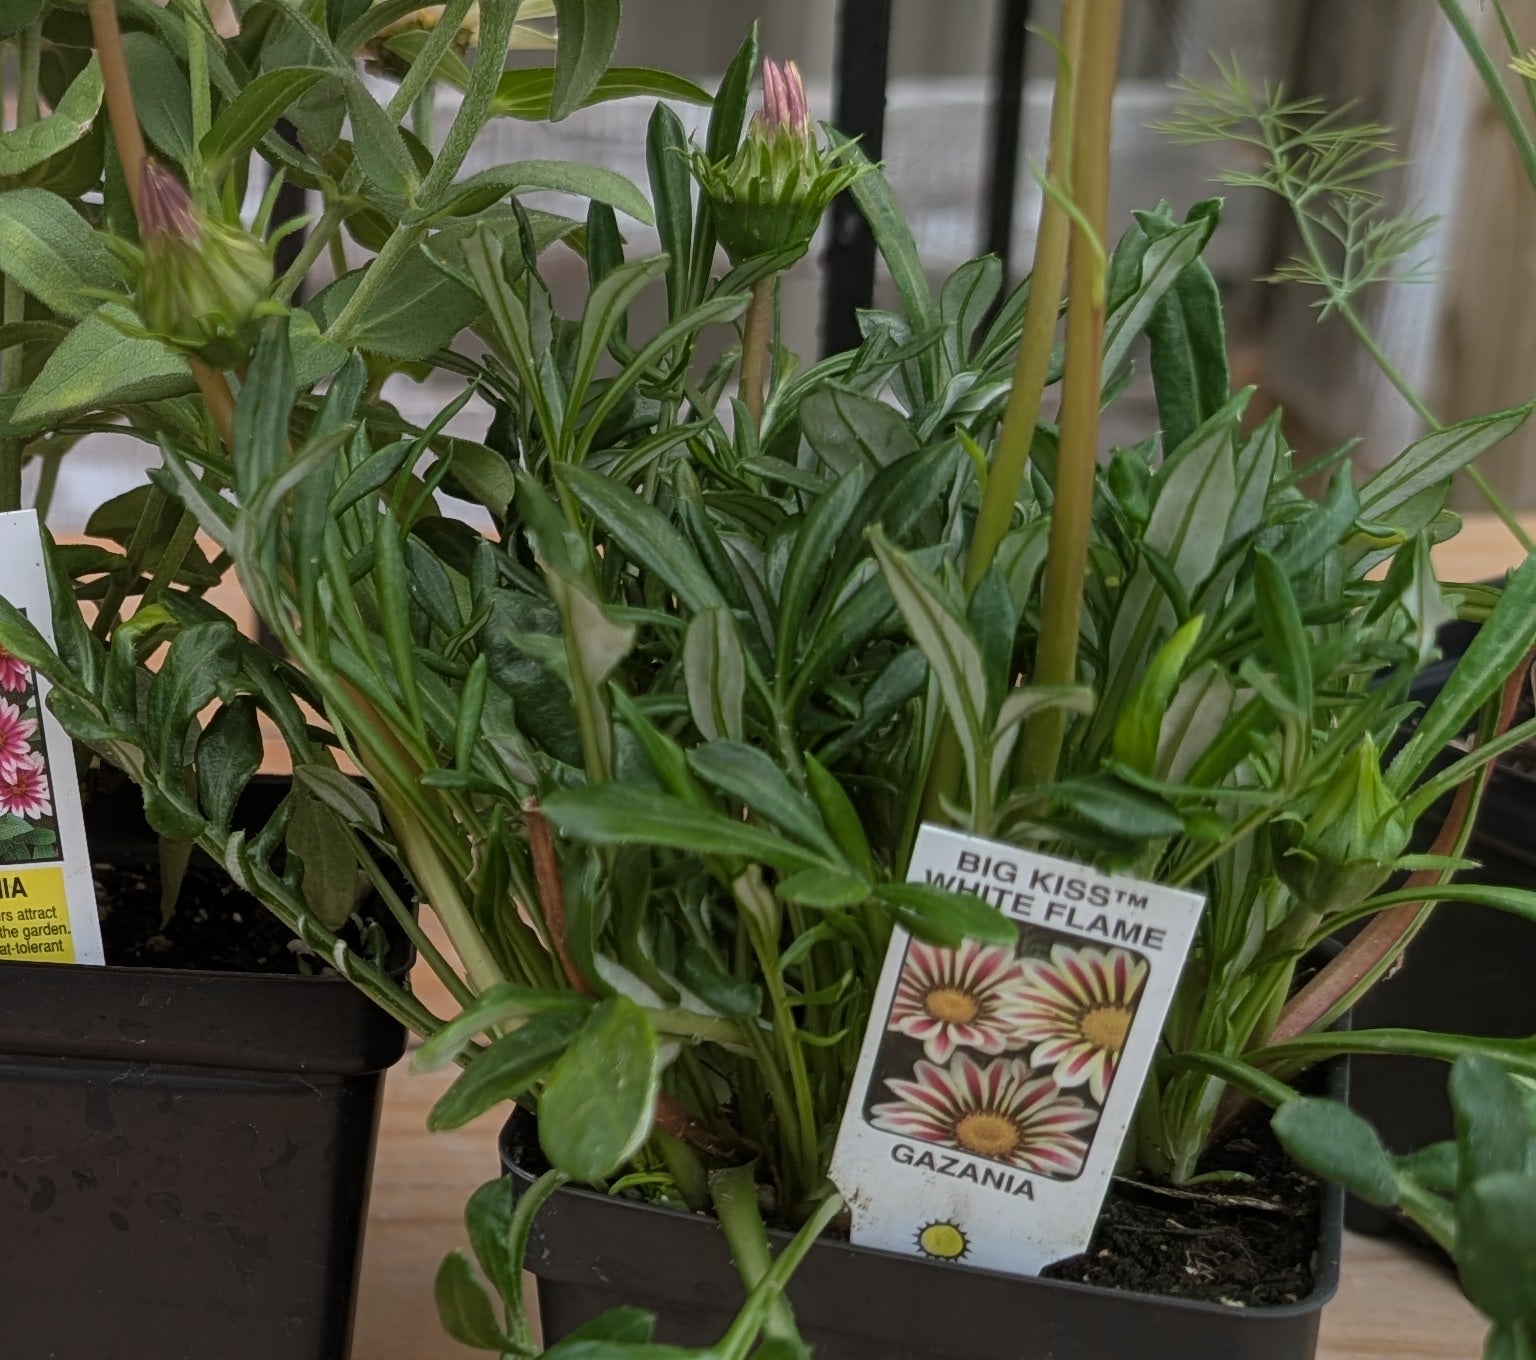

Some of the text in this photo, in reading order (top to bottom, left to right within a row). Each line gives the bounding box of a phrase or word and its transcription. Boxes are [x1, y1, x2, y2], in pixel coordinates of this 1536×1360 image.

[957, 850, 1019, 884] BIG
[16, 905, 57, 921] attract
[1043, 900, 1167, 951] FLAME
[22, 922, 72, 941] garden.
[891, 1143, 1035, 1202] GAZANIA
